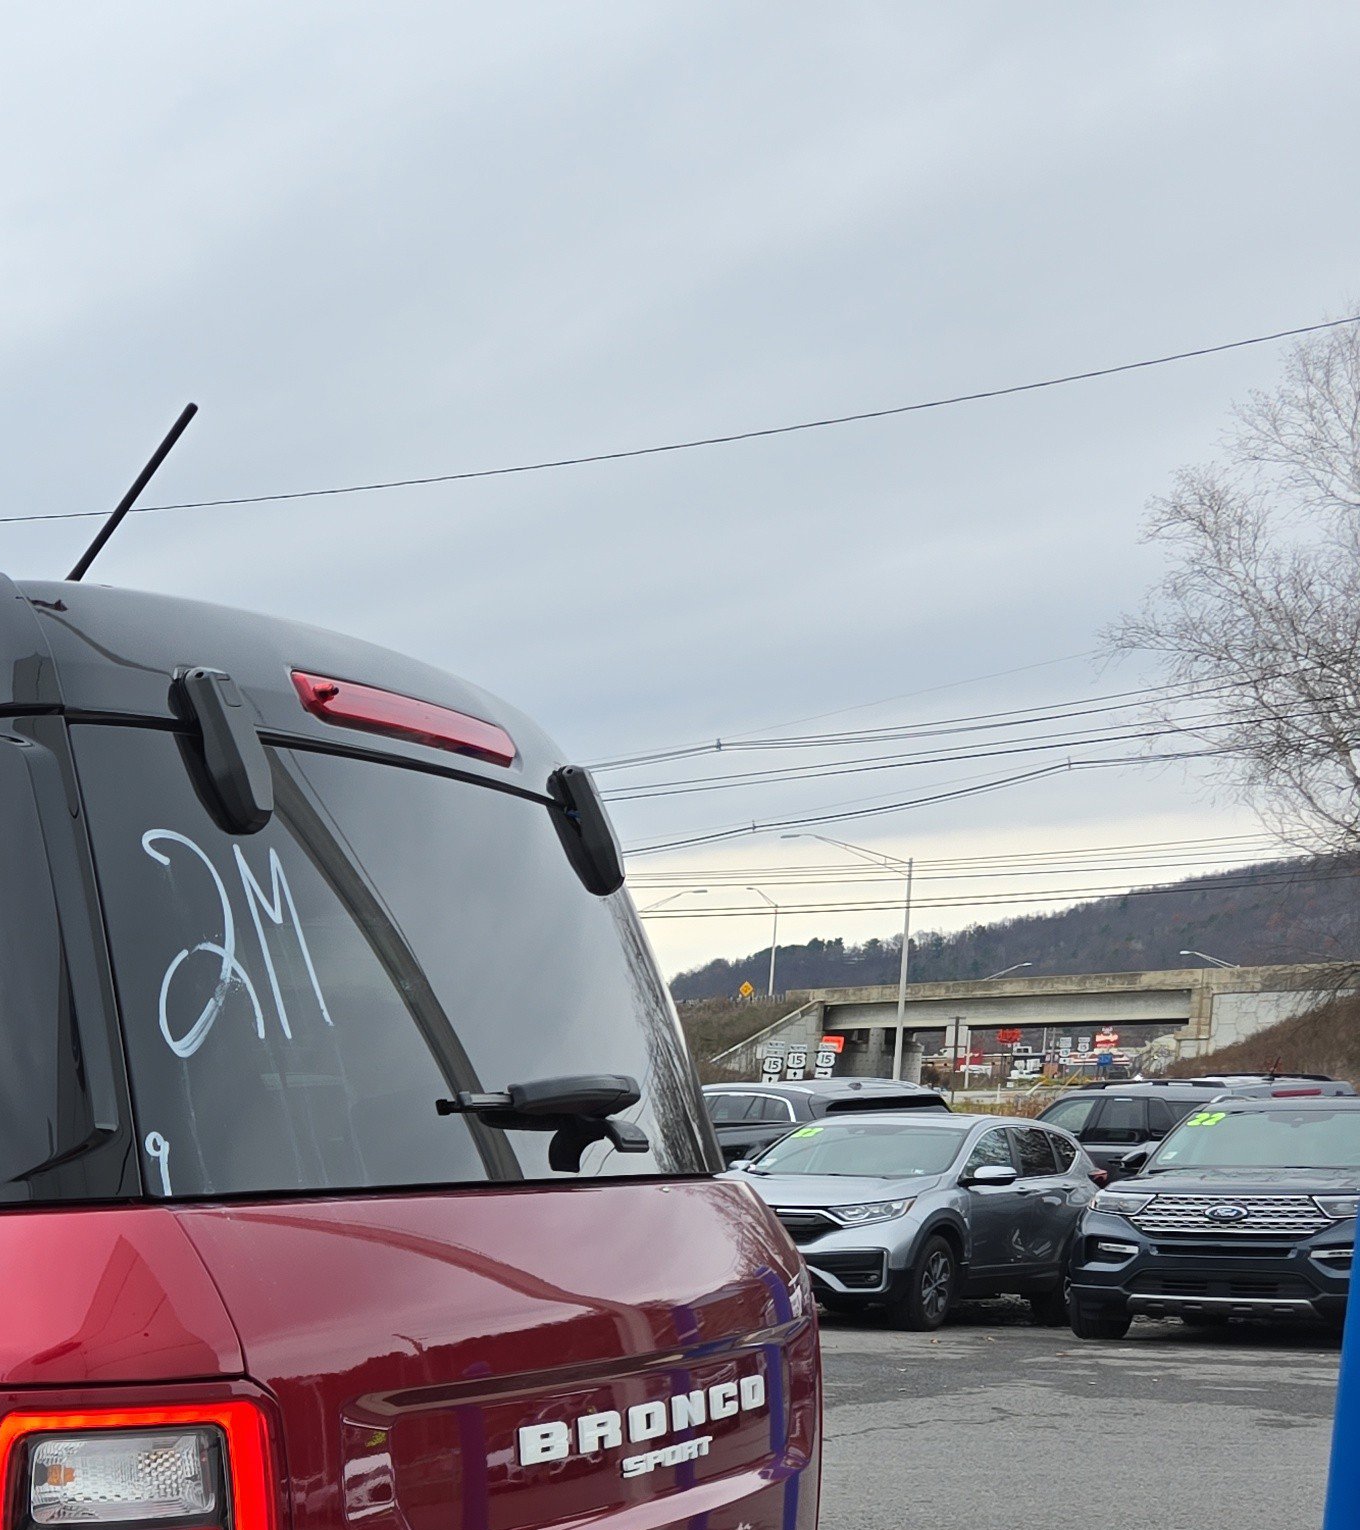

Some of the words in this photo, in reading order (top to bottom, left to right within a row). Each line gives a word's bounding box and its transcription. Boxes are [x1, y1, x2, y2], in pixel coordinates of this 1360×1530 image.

[768, 1061, 779, 1069] 15
[792, 1056, 803, 1065] 15
[819, 1055, 832, 1064] 15
[1187, 1112, 1226, 1126] 22
[519, 1374, 765, 1467] BRONCO
[622, 1435, 713, 1479] SPORT
